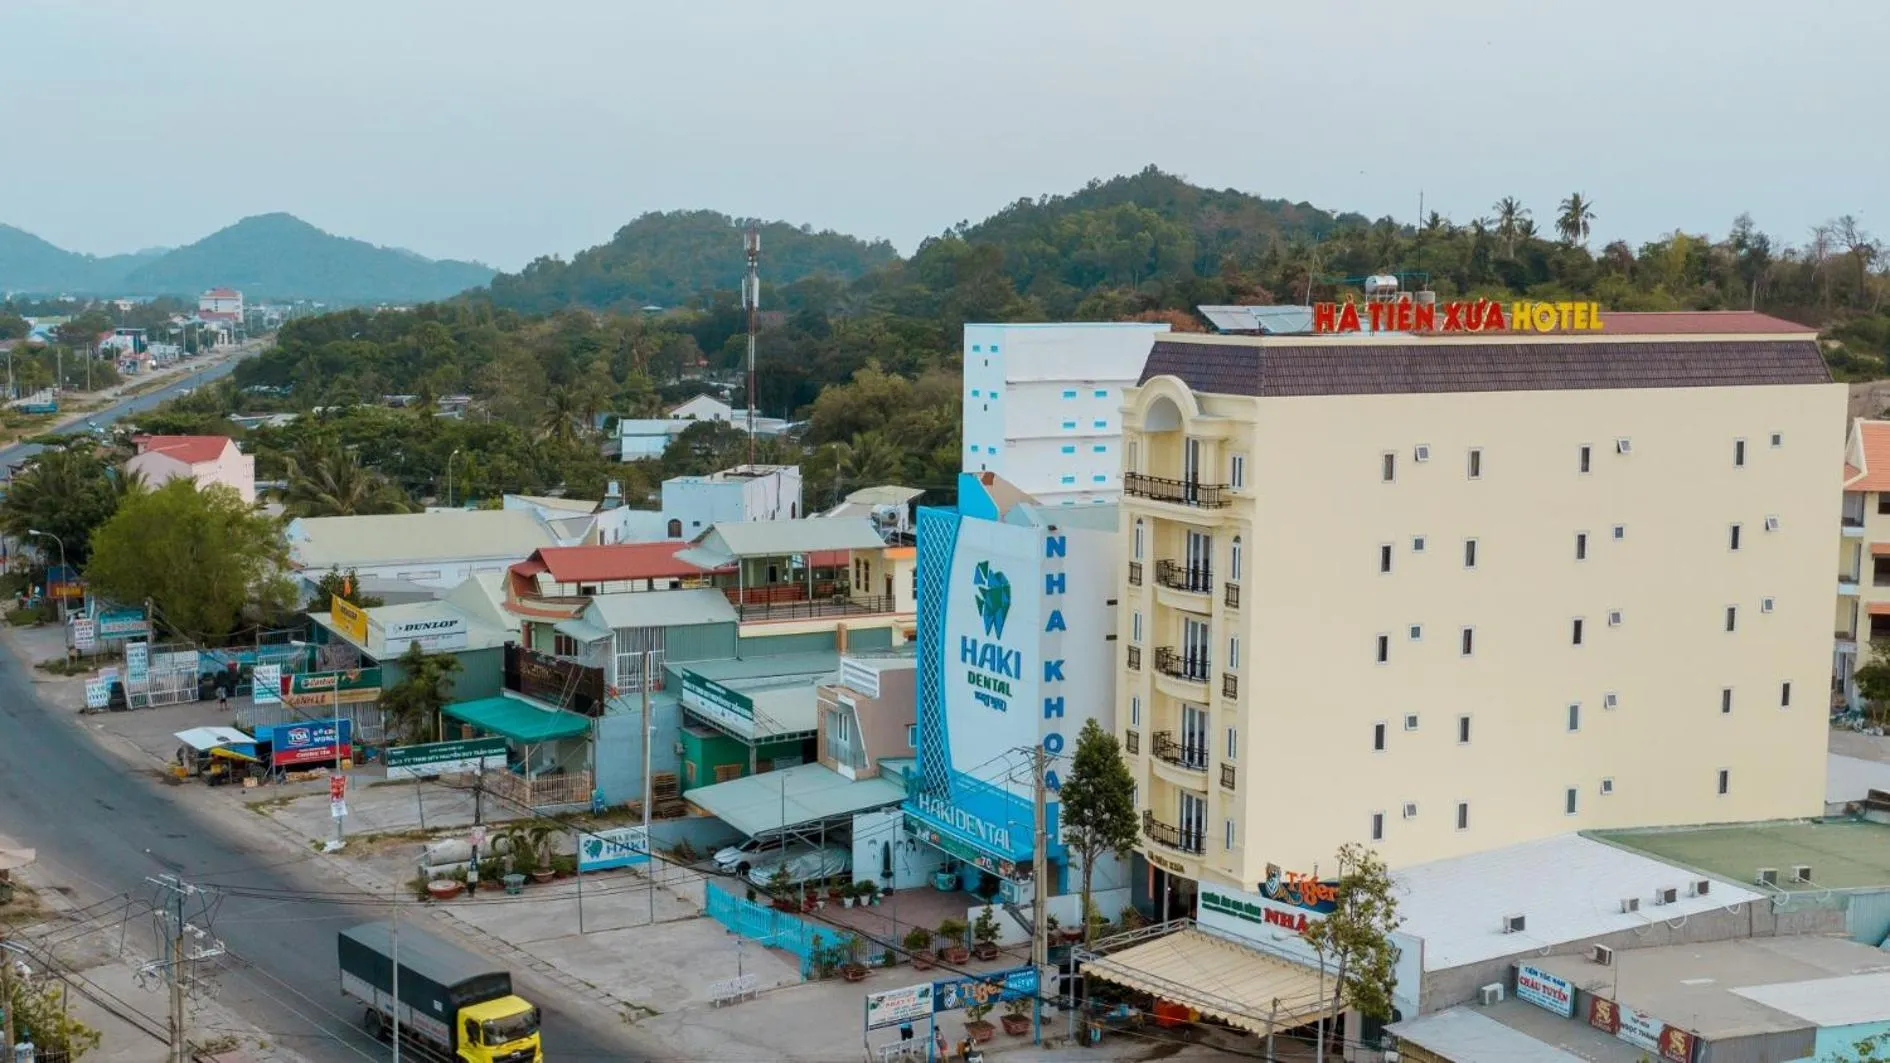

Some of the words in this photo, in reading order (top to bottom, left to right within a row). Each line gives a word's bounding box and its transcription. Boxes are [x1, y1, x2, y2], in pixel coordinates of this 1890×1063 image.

[1314, 293, 1361, 333] HÀ
[1366, 296, 1435, 333] TIÊN
[1440, 296, 1505, 332] XƯA
[1511, 301, 1604, 332] HOTEL
[1045, 536, 1067, 632] NHA
[403, 620, 458, 632] DUNLOP
[960, 635, 1022, 680] HAKI
[967, 670, 1013, 698] DENTAL
[313, 735, 339, 743] WORL
[1043, 659, 1065, 792] KHOA
[1285, 870, 1340, 906] Tiger
